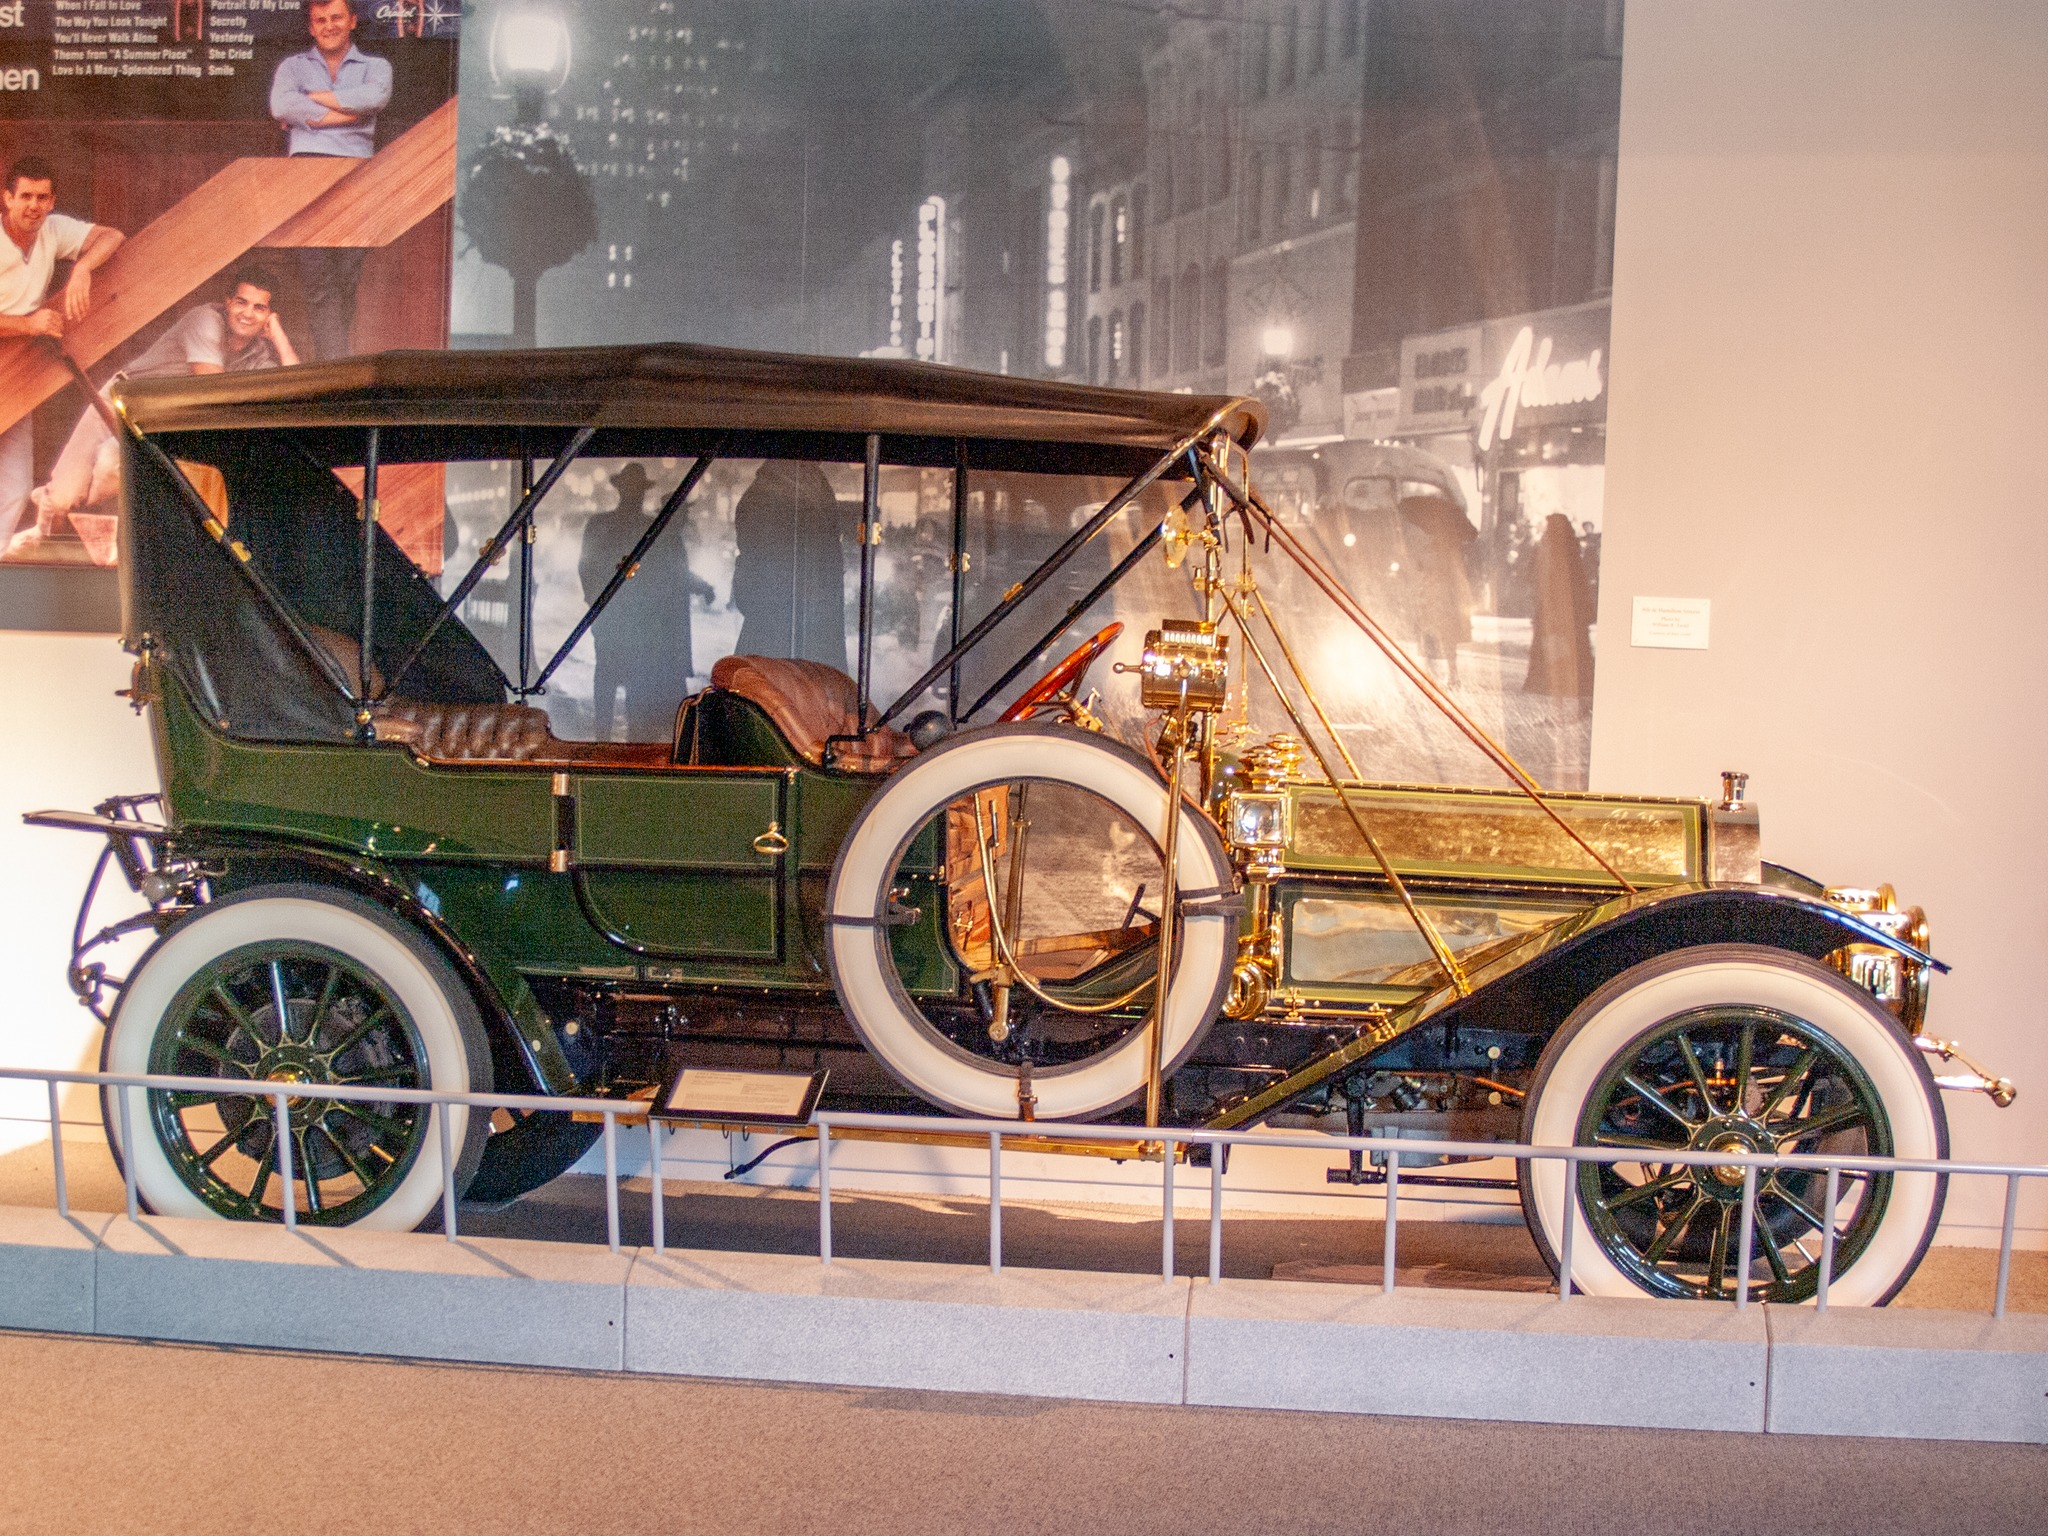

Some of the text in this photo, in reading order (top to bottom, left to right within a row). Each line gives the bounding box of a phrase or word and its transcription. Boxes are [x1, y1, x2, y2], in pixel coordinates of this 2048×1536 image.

[56, 0, 81, 10] When
[89, 0, 106, 10] Fall
[108, 0, 118, 10] In
[120, 0, 141, 10] Love
[211, 0, 247, 10] Portrait
[262, 0, 277, 12] My
[278, 0, 301, 10] Love
[55, 16, 168, 30] The Way You Look Tonight
[210, 16, 248, 29] Secretly
[54, 32, 158, 44] You'll Never Walk Alone
[209, 32, 254, 45] Yesterday
[54, 49, 85, 60] Theme
[86, 49, 108, 60] from
[122, 48, 161, 60] Summer
[208, 48, 253, 60] She Cried
[52, 64, 74, 76] Love
[75, 64, 84, 76] Is
[85, 64, 92, 76] A
[174, 64, 202, 78] Thing
[207, 64, 235, 76] Smile
[0, 68, 40, 91] en
